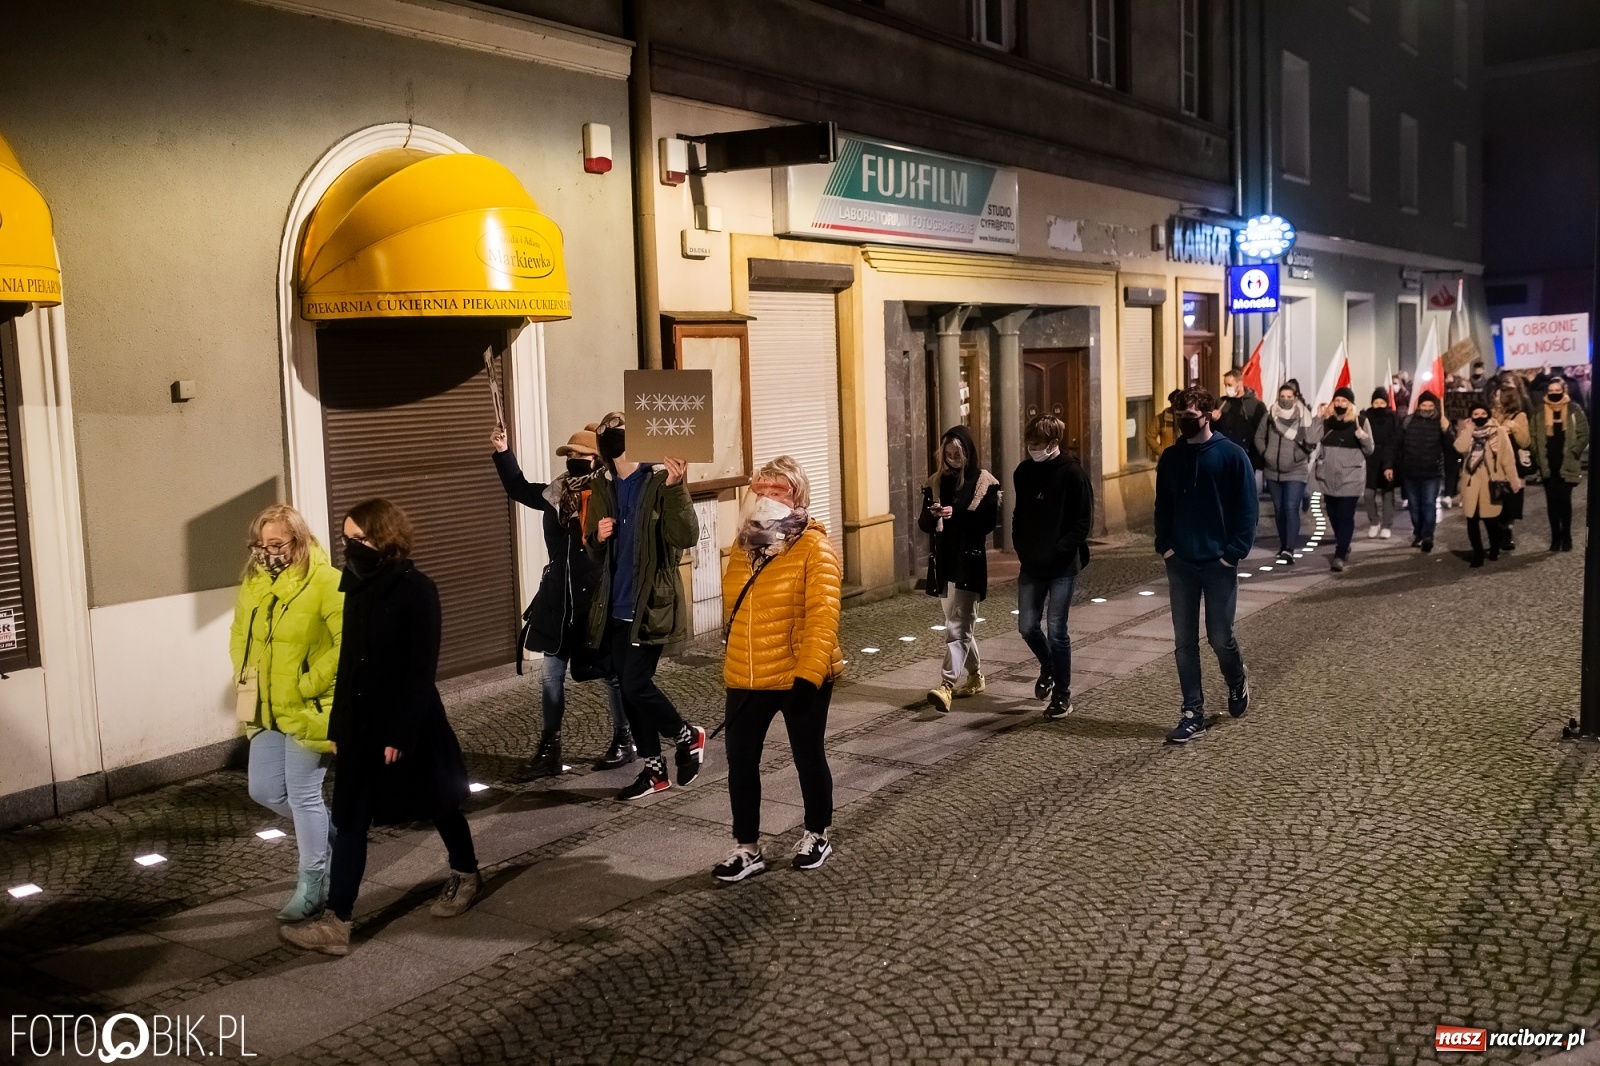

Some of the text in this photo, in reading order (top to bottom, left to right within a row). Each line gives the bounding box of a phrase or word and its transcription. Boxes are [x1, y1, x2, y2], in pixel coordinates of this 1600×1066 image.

[862, 153, 968, 207] FUJIFILM
[839, 204, 975, 235] LABORATORIUM FOTOGRAFICZNE
[988, 203, 1012, 218] STUDIO
[1173, 221, 1231, 264] KANTOR
[488, 248, 551, 270] Markiewka
[0, 277, 24, 292] NIA
[307, 300, 373, 314] PIEKARNIA
[377, 298, 458, 312] CUKIERNIA
[463, 297, 527, 311] PIEKARNIA
[1506, 318, 1578, 337] W OBRONIE
[1509, 335, 1577, 356] WOLNOŚCI
